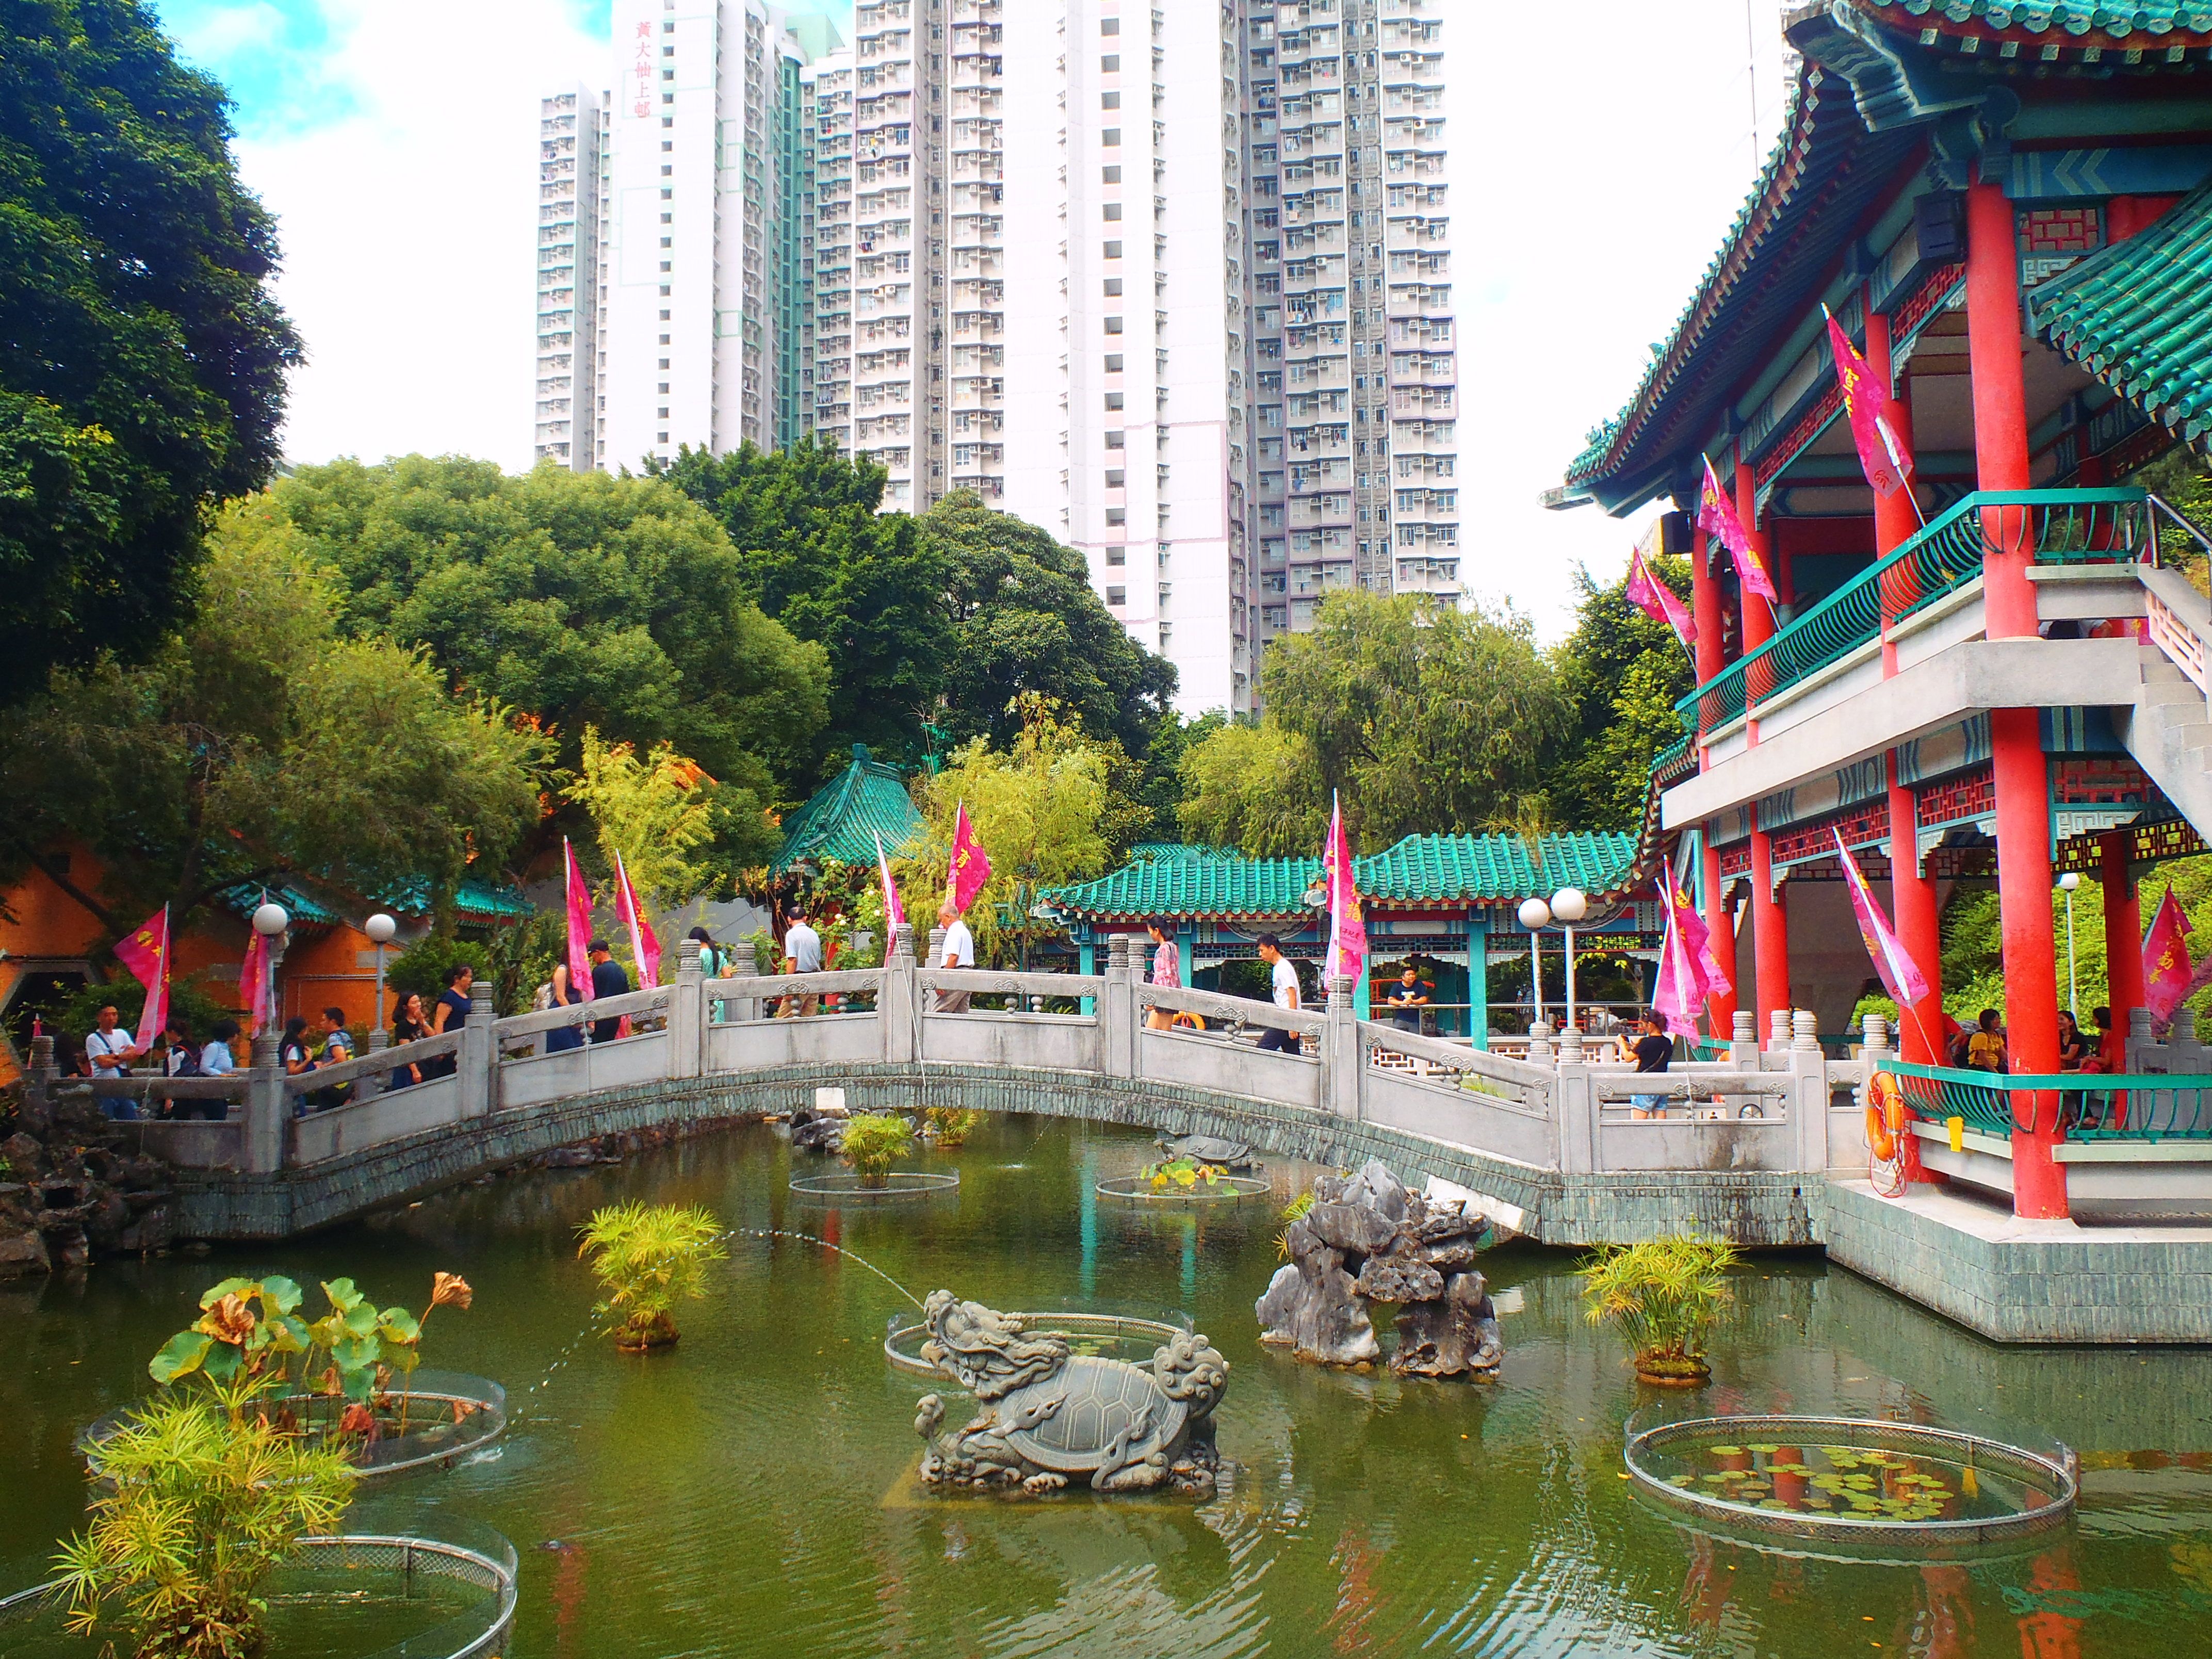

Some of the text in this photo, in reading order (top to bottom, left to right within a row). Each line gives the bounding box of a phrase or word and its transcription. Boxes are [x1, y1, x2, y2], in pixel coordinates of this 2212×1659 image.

[635, 21, 652, 118] 黃大仙上邨
